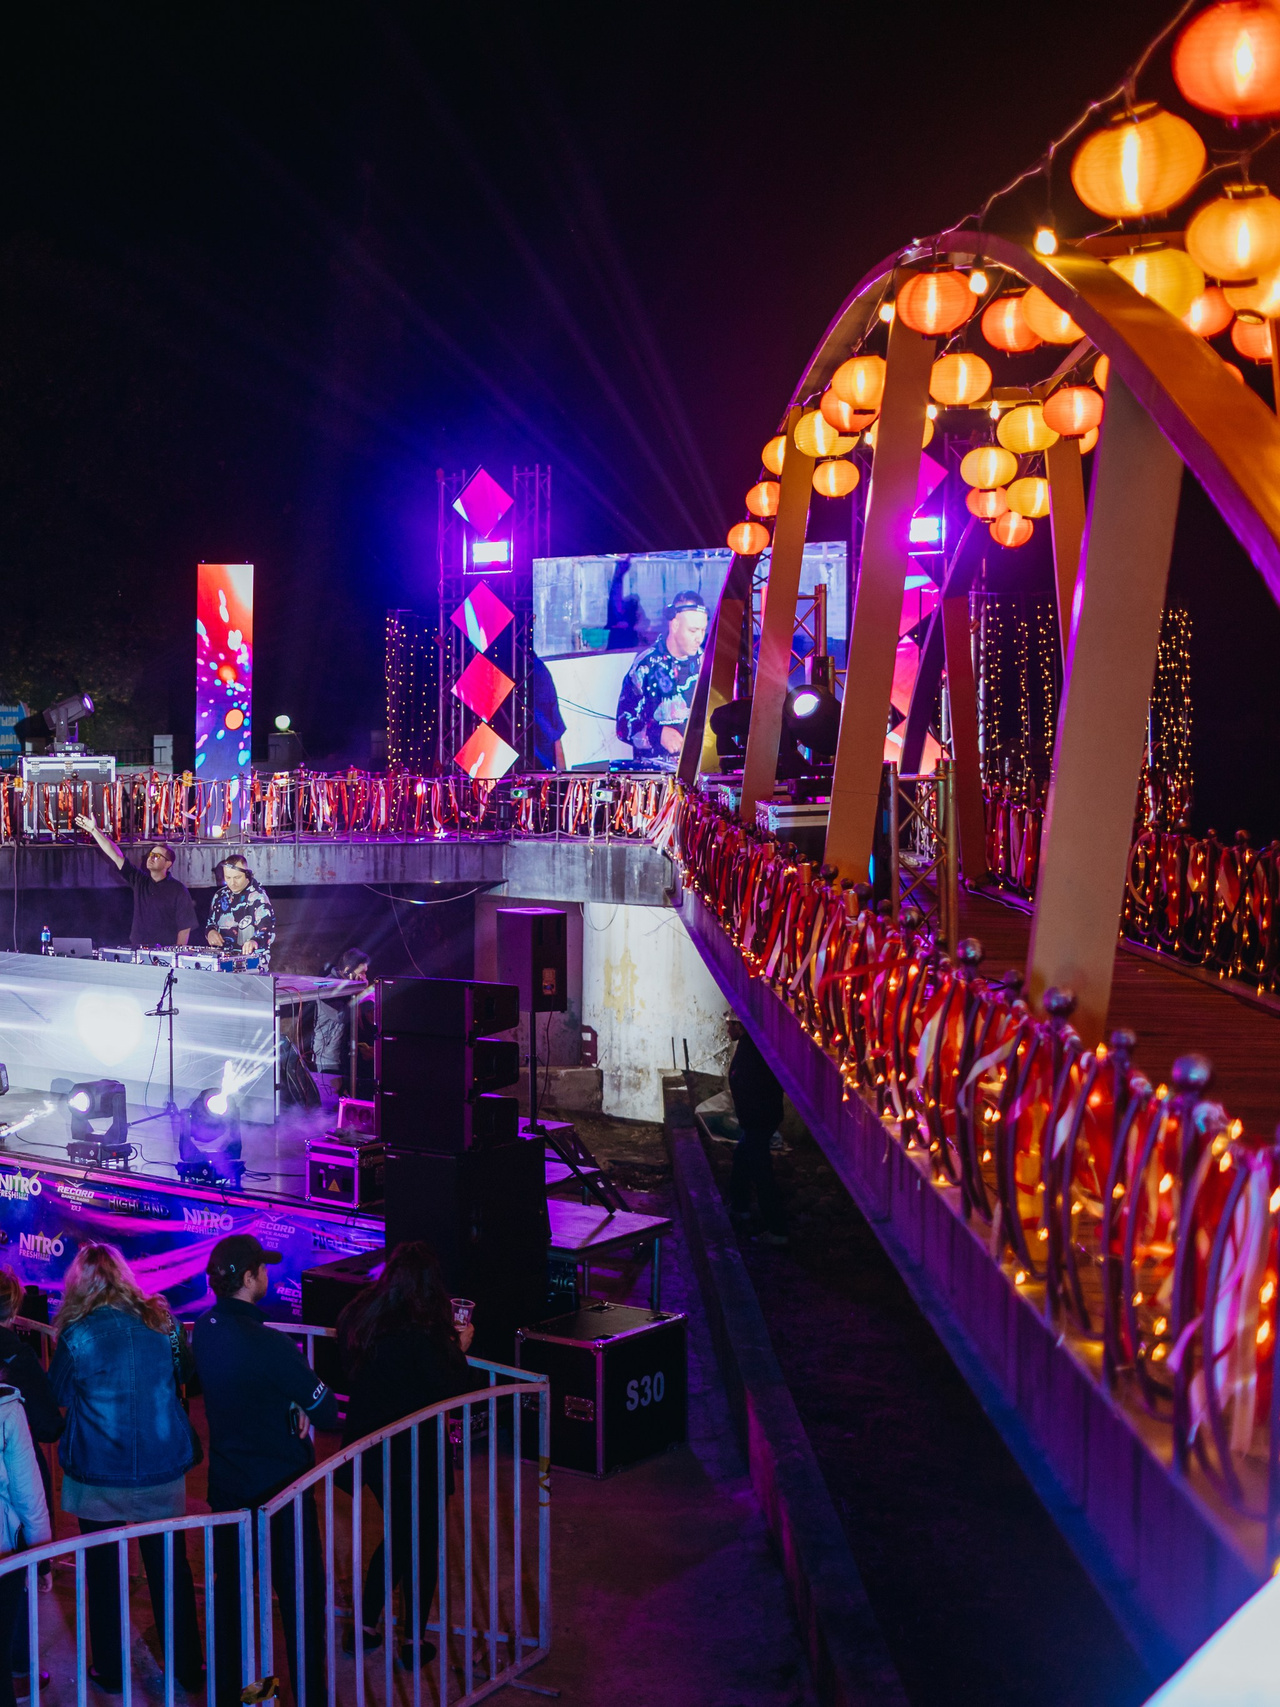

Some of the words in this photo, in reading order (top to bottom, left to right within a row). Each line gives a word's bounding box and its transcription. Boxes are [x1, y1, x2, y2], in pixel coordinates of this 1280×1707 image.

[57, 1185, 95, 1199] RECORD
[108, 1195, 171, 1220] HIGHLAND
[183, 1207, 234, 1231] NITRO
[254, 1219, 296, 1235] RECORD
[19, 1232, 65, 1257] NITRO
[626, 1371, 665, 1411] S30
